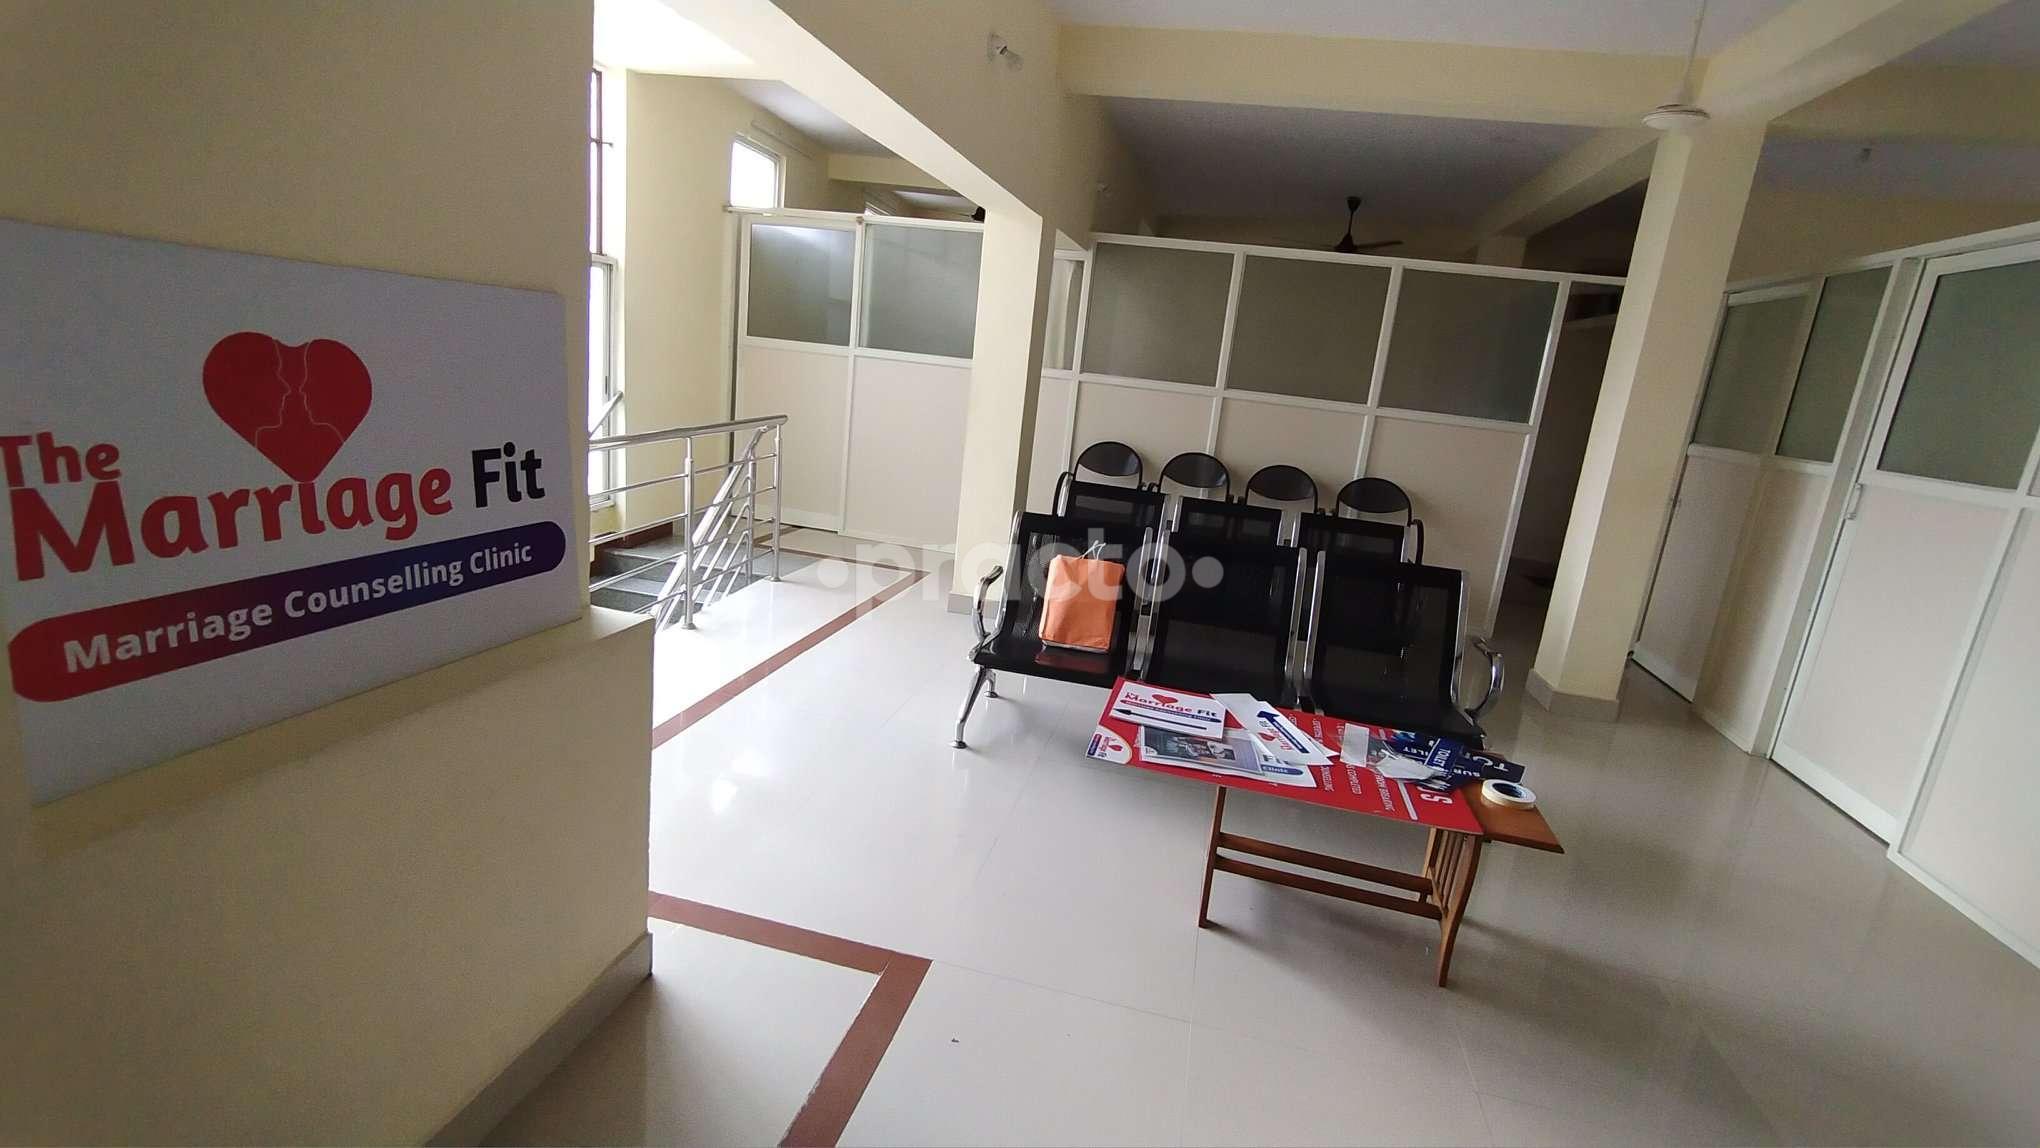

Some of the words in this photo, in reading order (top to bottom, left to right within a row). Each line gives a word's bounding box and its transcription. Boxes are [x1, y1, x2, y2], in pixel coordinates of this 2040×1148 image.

[0, 431, 122, 487] The
[10, 467, 454, 582] Marriage
[472, 441, 546, 508] Fit
[64, 602, 273, 673] Marriage
[284, 560, 464, 618] Counselling
[470, 541, 533, 575] Clinic
[1124, 694, 1193, 713] Marriage
